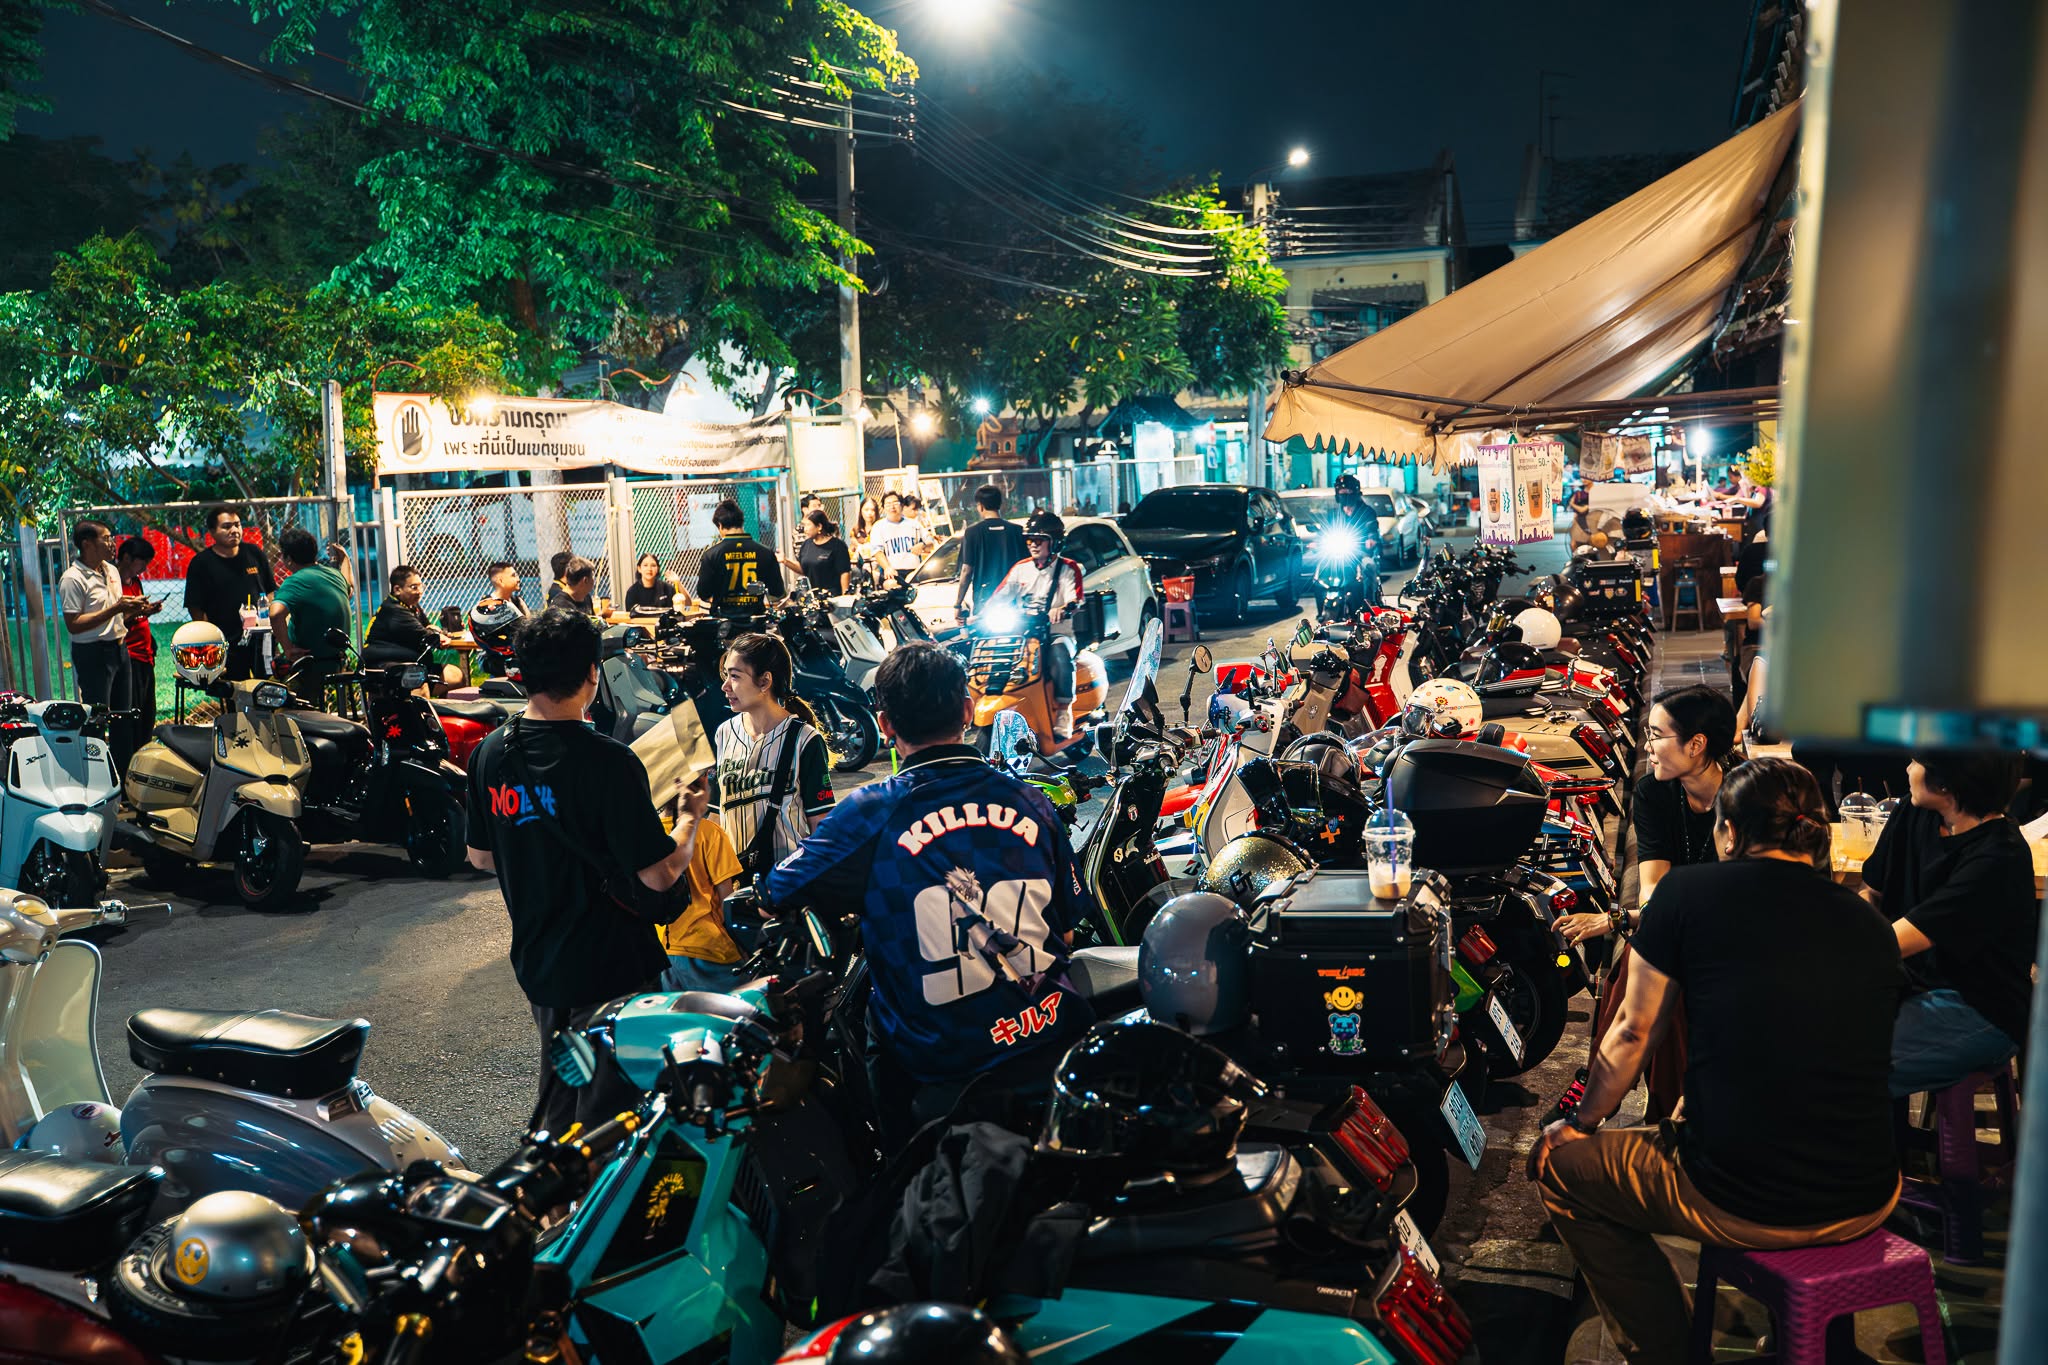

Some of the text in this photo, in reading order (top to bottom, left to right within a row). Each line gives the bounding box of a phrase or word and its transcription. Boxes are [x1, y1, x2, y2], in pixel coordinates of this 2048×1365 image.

[443, 430, 586, 463] เพระที่นี่เป็นเขตชุมชน
[725, 561, 758, 591] 76
[897, 802, 1040, 857] KILLUA
[990, 991, 1063, 1046] キルア
